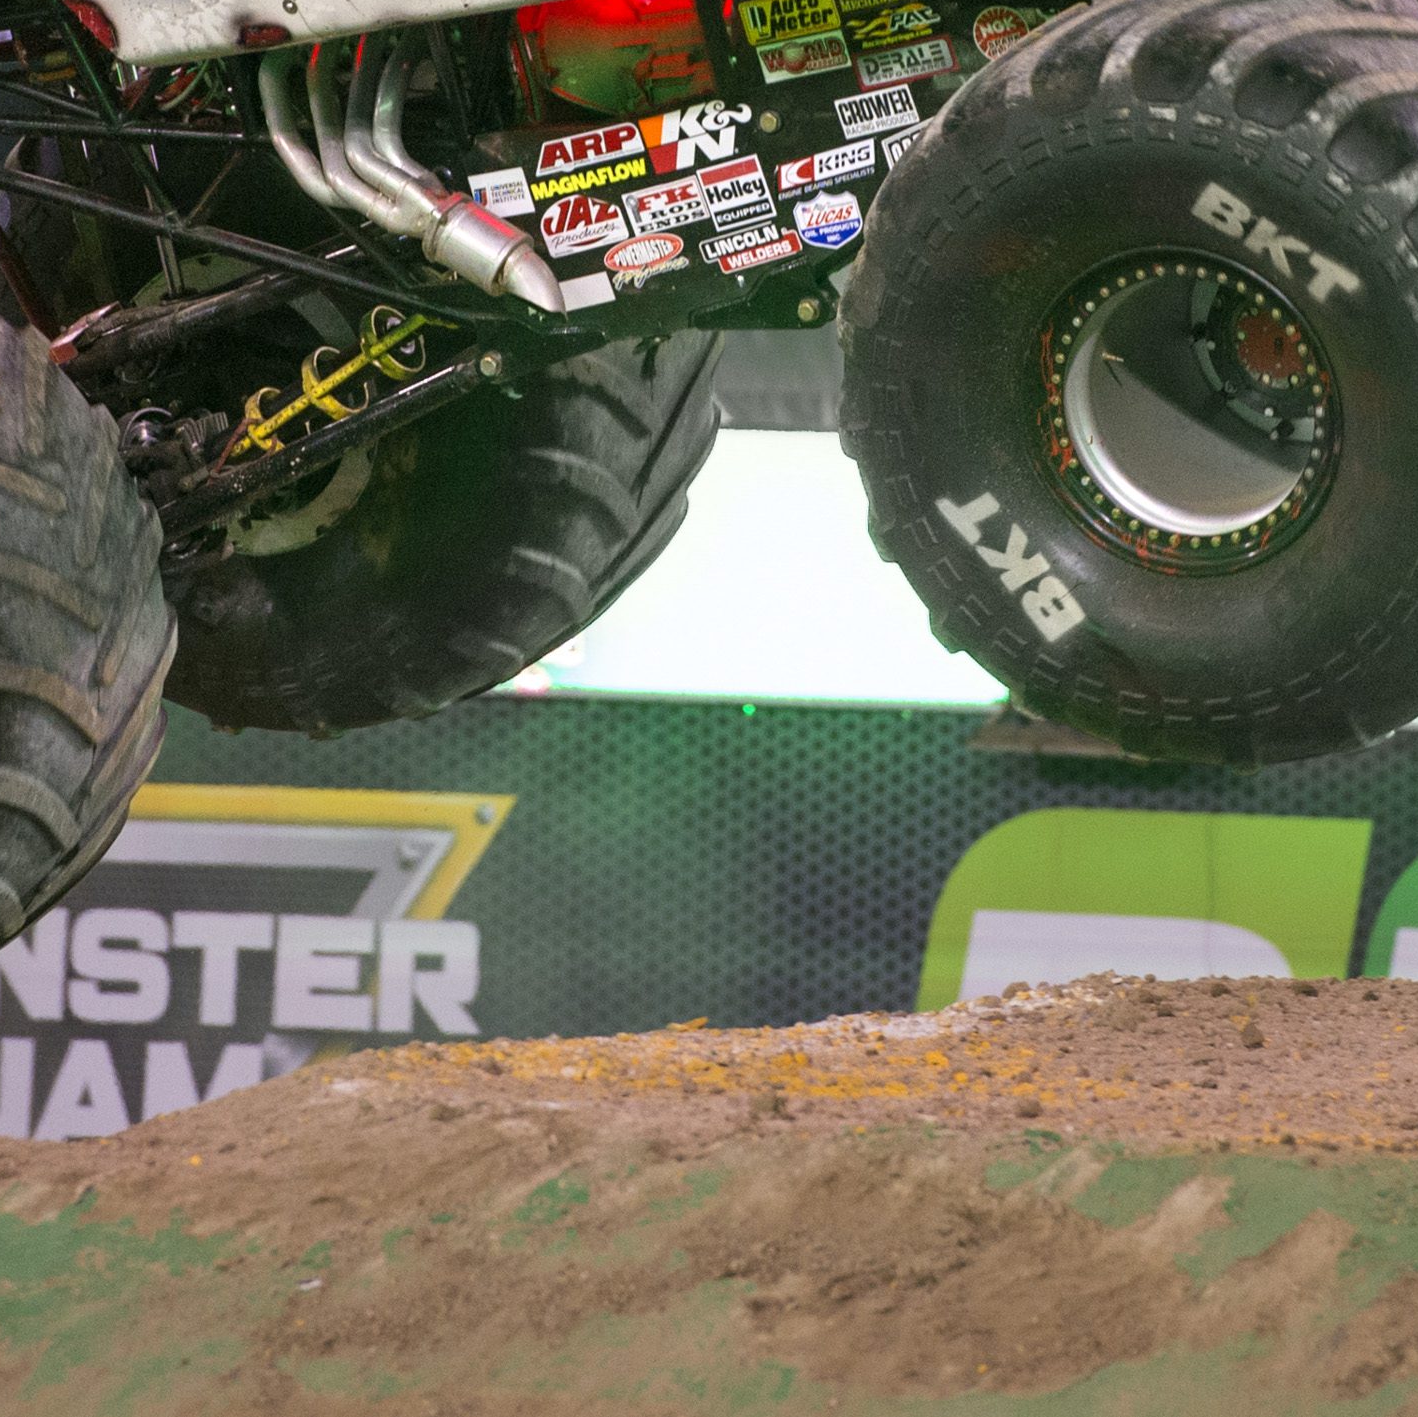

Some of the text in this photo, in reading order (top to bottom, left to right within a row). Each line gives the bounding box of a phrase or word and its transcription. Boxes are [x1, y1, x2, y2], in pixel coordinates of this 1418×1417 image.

[770, 8, 834, 38] Meter
[980, 16, 1018, 38] NGK
[862, 41, 945, 75] DERALE
[838, 88, 913, 126] CROWER
[845, 111, 918, 137] RACING PRODUCTS
[540, 125, 637, 170] ARP
[819, 145, 871, 174] KING
[490, 180, 523, 191] UNIVERSAL
[491, 187, 524, 198] TECHNICAL
[531, 158, 646, 201] MAGNAFLOW
[705, 176, 766, 205] Holley
[778, 165, 875, 201] ENGINE BEARING SPECIALISTS
[492, 194, 526, 205] INSTITUTE
[638, 182, 698, 212] FK
[650, 199, 702, 220] ROD
[543, 195, 619, 236] JAZ
[639, 209, 705, 233] ENDS
[716, 202, 771, 224] EQUIPPED
[807, 205, 853, 228] LUCAS
[704, 224, 780, 260] LINCOLN
[804, 221, 859, 238] OIL PRODUCTS
[1191, 181, 1364, 303] BKT
[614, 238, 674, 267] POWERMASTER
[726, 239, 792, 270] WELDERS
[936, 490, 1087, 644] BKT
